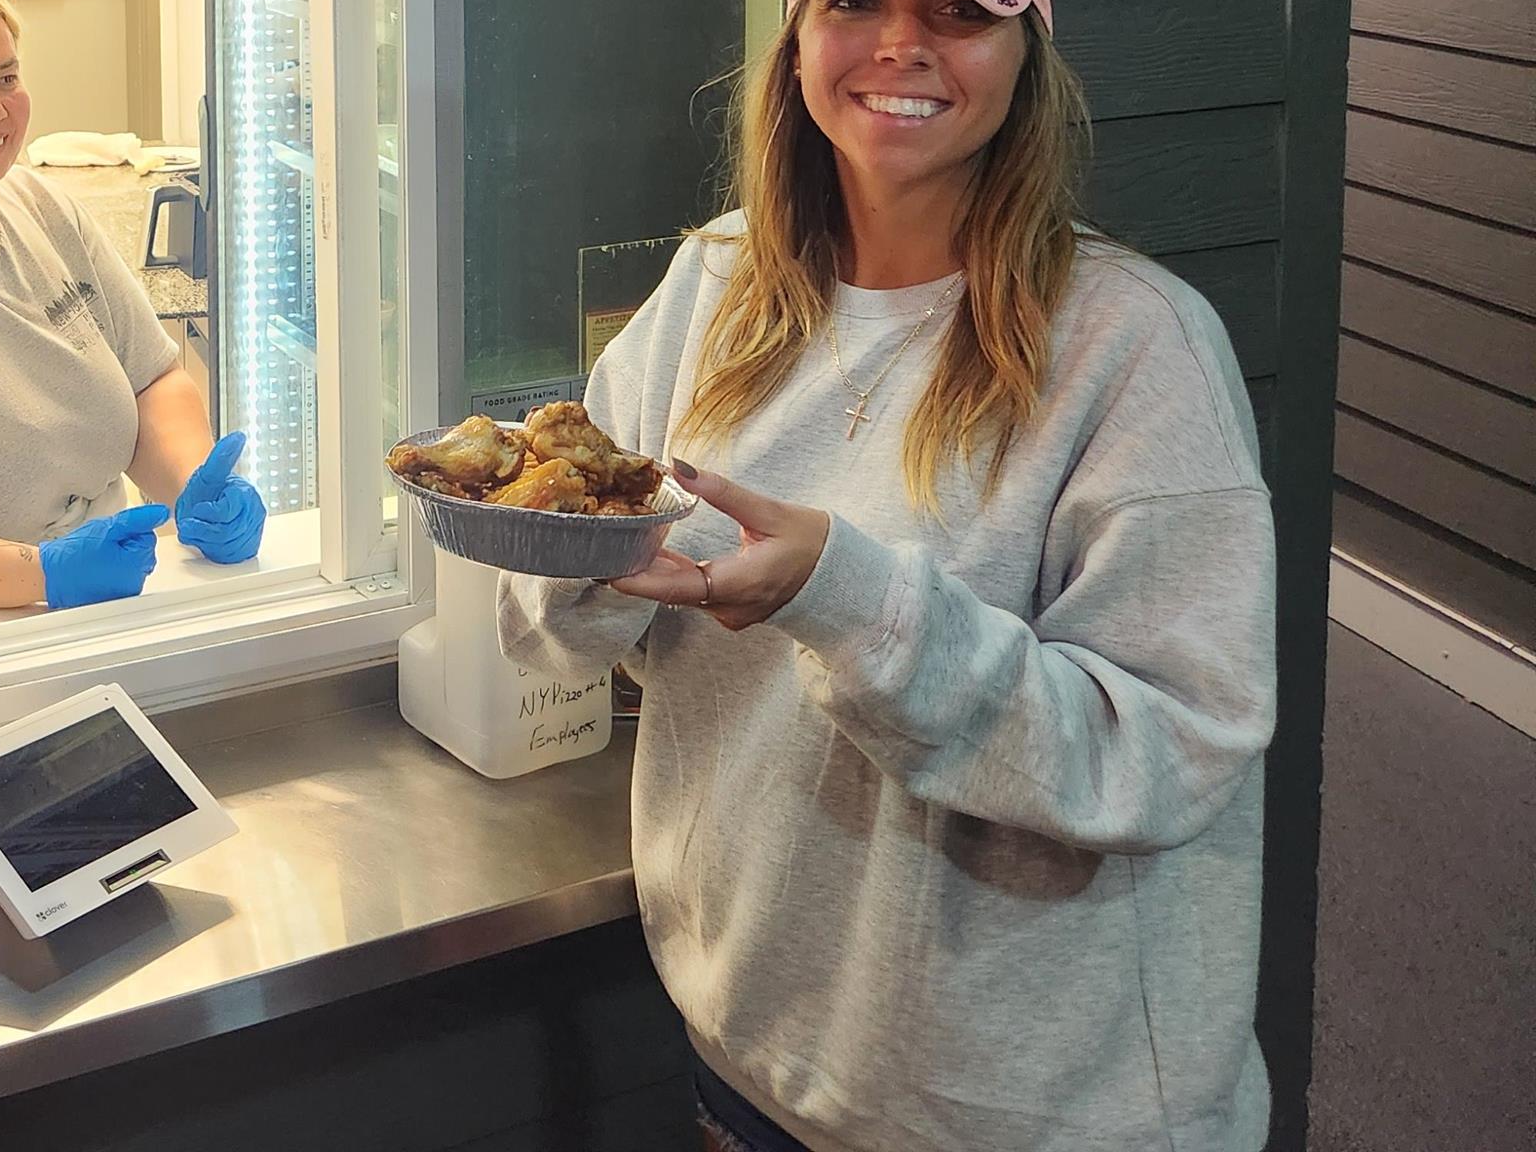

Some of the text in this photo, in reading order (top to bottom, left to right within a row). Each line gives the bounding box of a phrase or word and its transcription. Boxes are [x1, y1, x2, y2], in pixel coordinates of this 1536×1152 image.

[484, 389, 559, 407] FOOD GRADE RATING
[44, 901, 68, 917] clover
